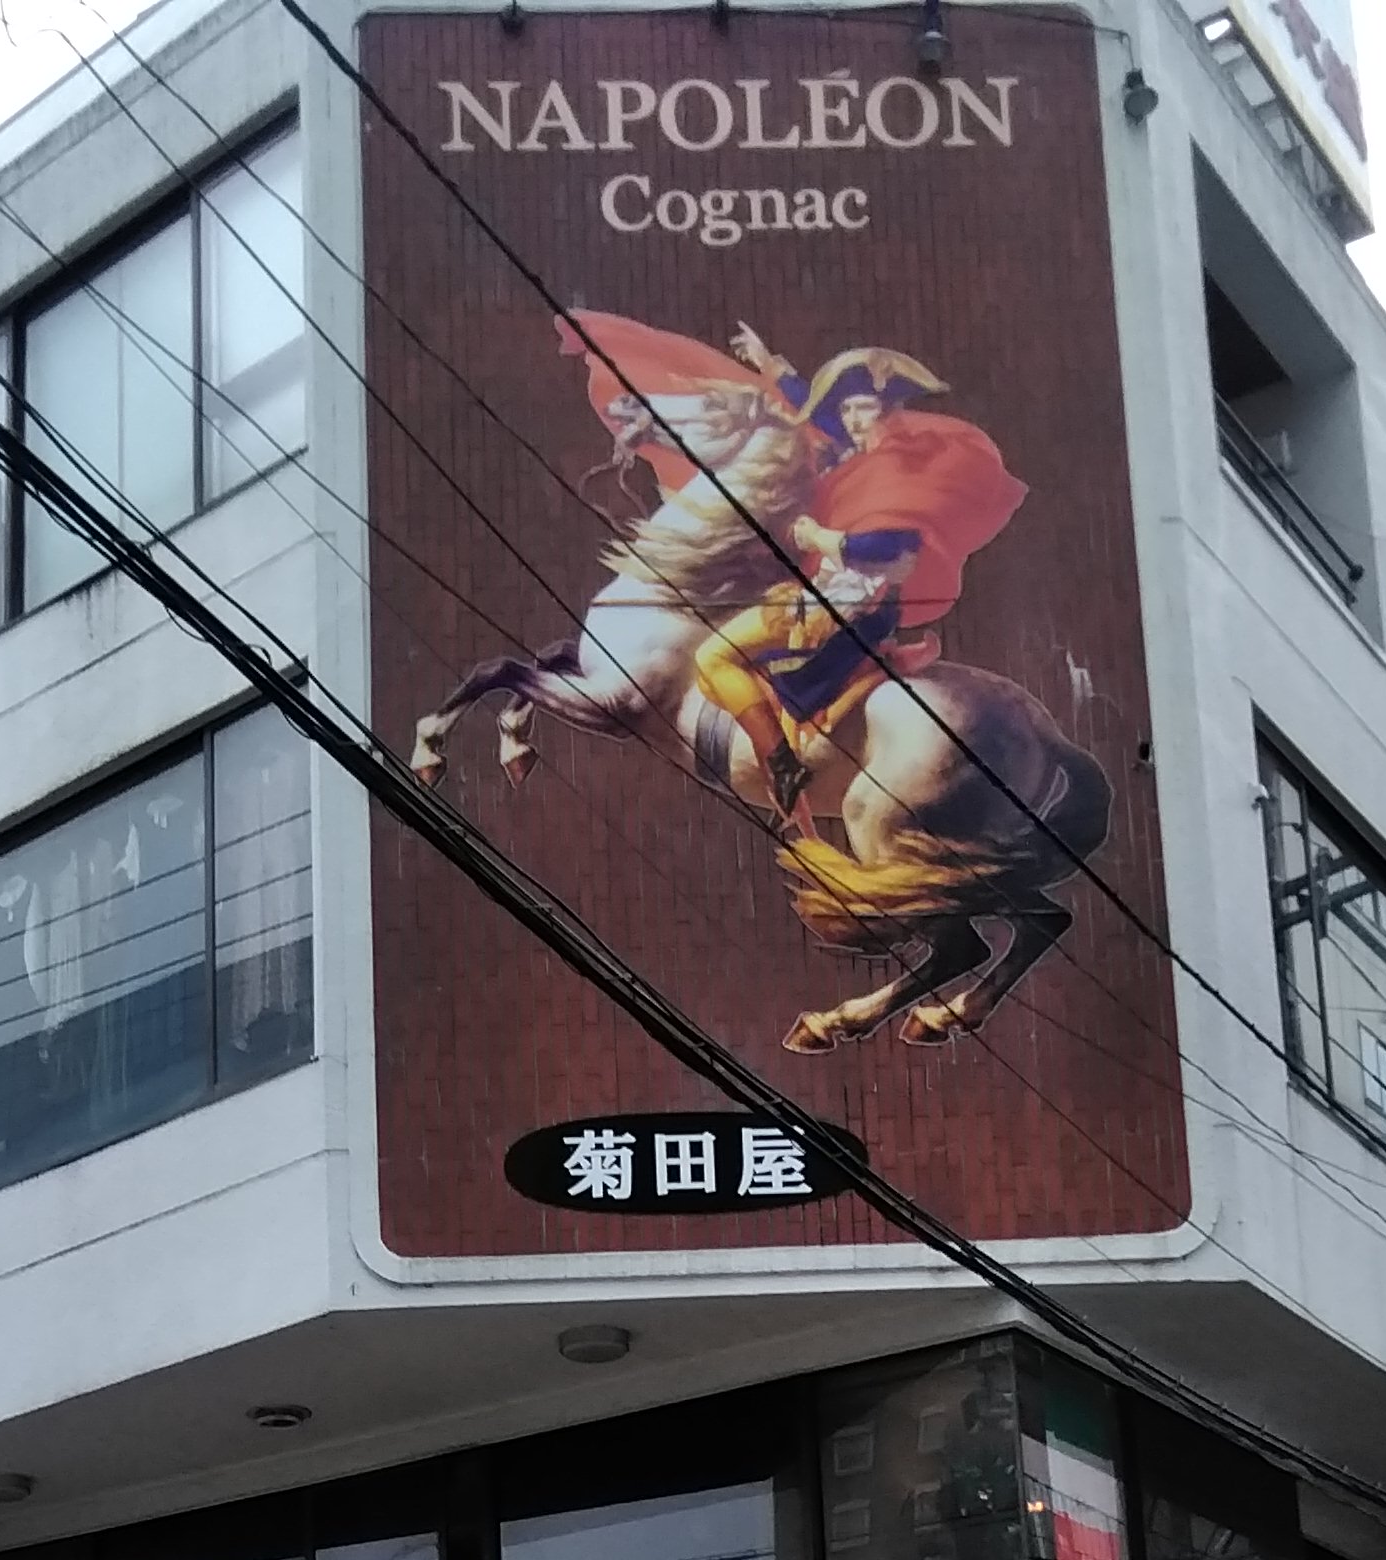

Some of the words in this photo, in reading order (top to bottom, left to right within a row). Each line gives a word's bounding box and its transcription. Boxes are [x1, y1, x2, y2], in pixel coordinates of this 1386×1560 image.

[439, 68, 1019, 153] NAPOLÉON
[601, 175, 871, 246] Cognac
[563, 1127, 813, 1200] 菊田屋
